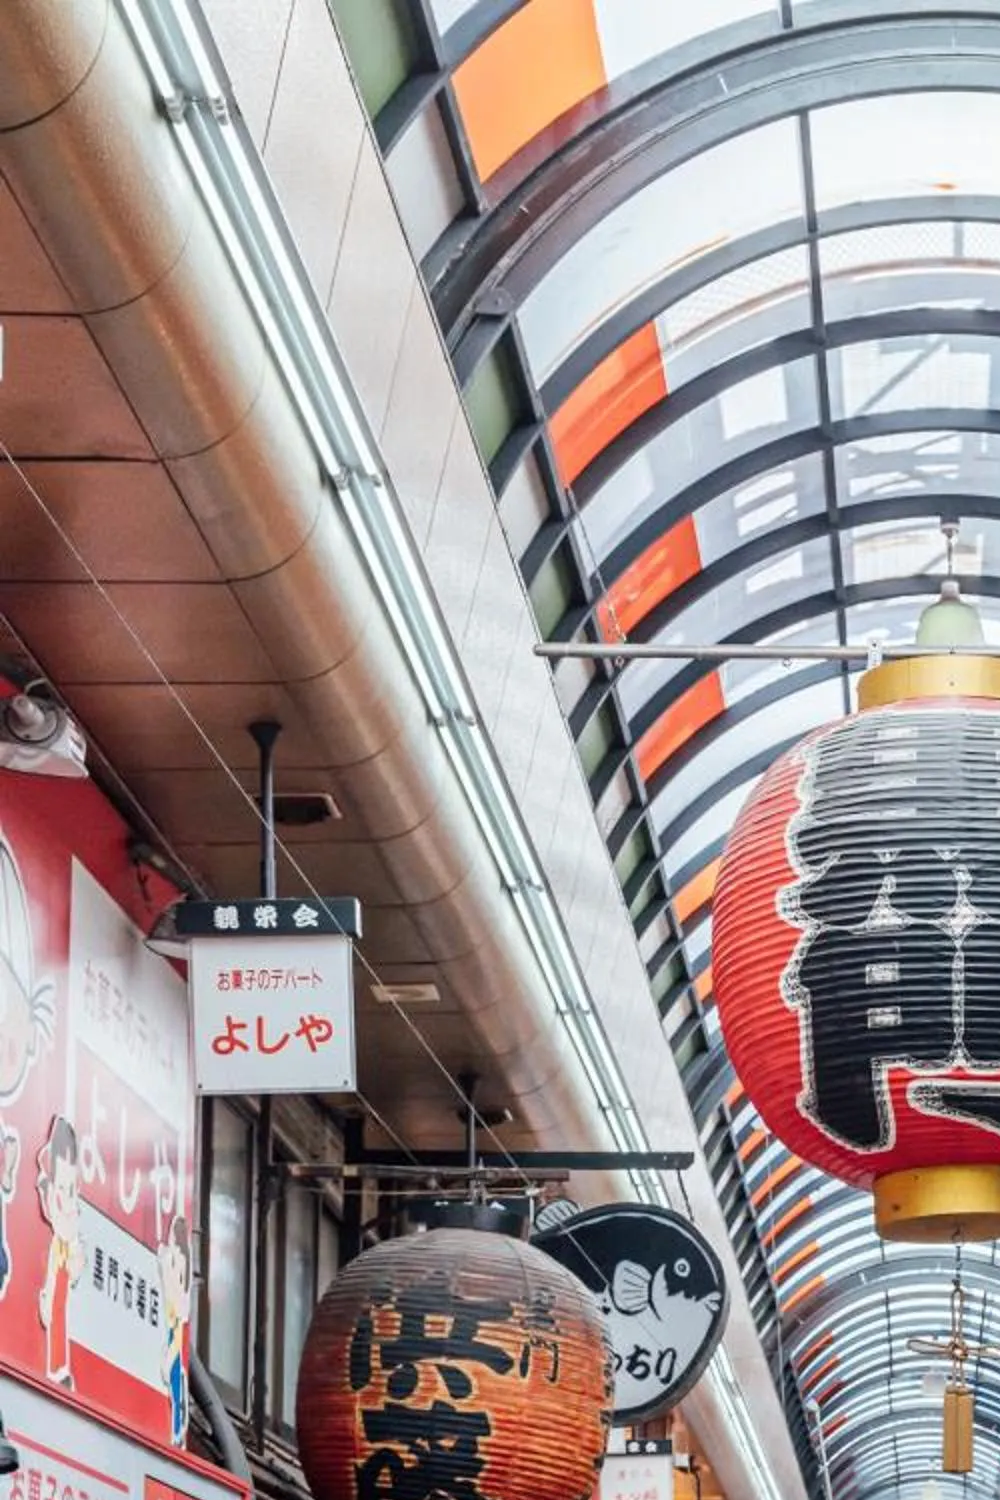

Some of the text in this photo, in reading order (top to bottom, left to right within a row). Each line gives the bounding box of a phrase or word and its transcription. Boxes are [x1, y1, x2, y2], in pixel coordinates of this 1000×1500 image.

[212, 1014, 334, 1056] よしや
[78, 1075, 178, 1240] よしや
